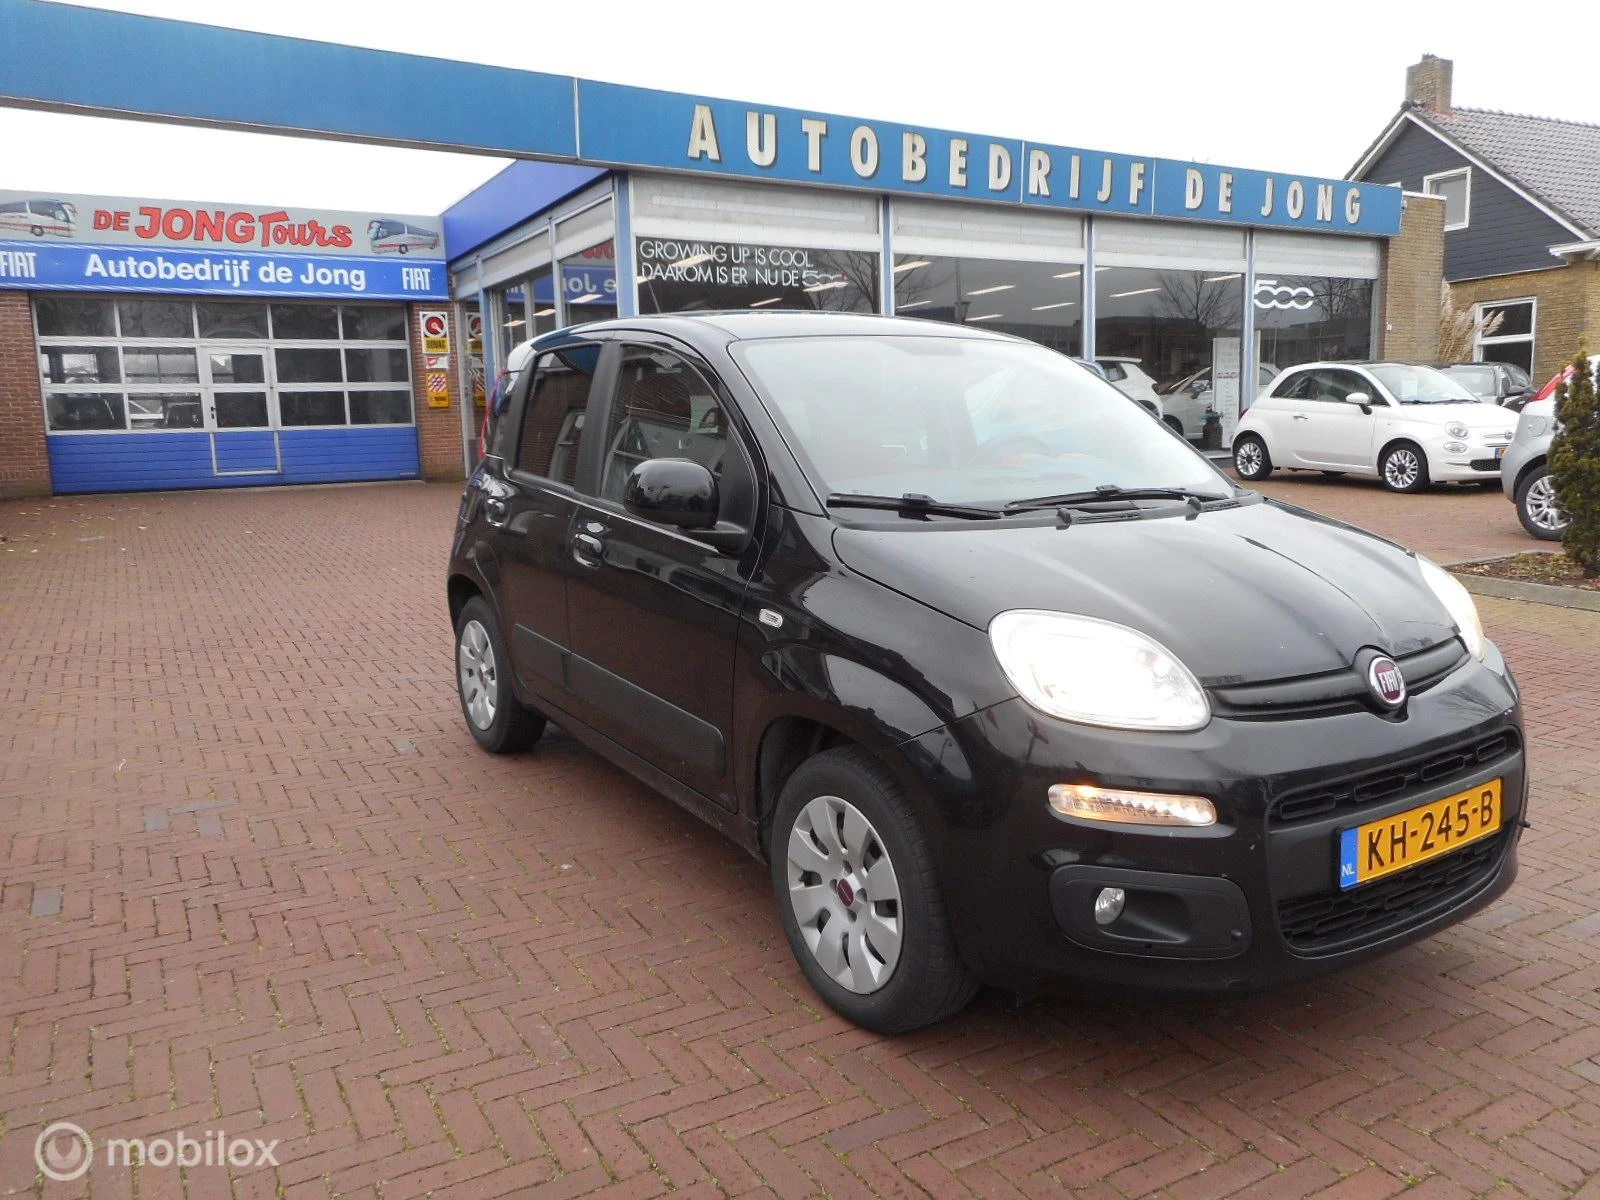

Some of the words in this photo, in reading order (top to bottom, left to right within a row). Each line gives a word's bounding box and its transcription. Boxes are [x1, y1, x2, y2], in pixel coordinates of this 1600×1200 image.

[687, 103, 1145, 206] AUTOBEDRIJF
[1185, 168, 1233, 213] DE
[1260, 178, 1361, 224] JONG
[93, 209, 131, 231] DE
[134, 206, 256, 244] JONG
[258, 210, 353, 248] Tours
[0, 250, 37, 278] FIAT
[640, 240, 728, 263] GROWING
[731, 246, 750, 264] UP
[754, 247, 767, 266] IS
[768, 249, 814, 268] COOL
[85, 253, 250, 288] Autobedrijf
[258, 260, 293, 284] de
[300, 262, 367, 292] Jong
[401, 267, 431, 291] FIAT
[641, 262, 714, 283] DAAROM
[716, 266, 728, 284] IS
[731, 267, 749, 285] ER
[755, 268, 778, 286] NU
[781, 269, 800, 287] DE
[1253, 279, 1315, 310] 500
[1377, 668, 1401, 693] FIAT
[1367, 789, 1494, 871] KH-245-B
[1341, 863, 1355, 876] NL
